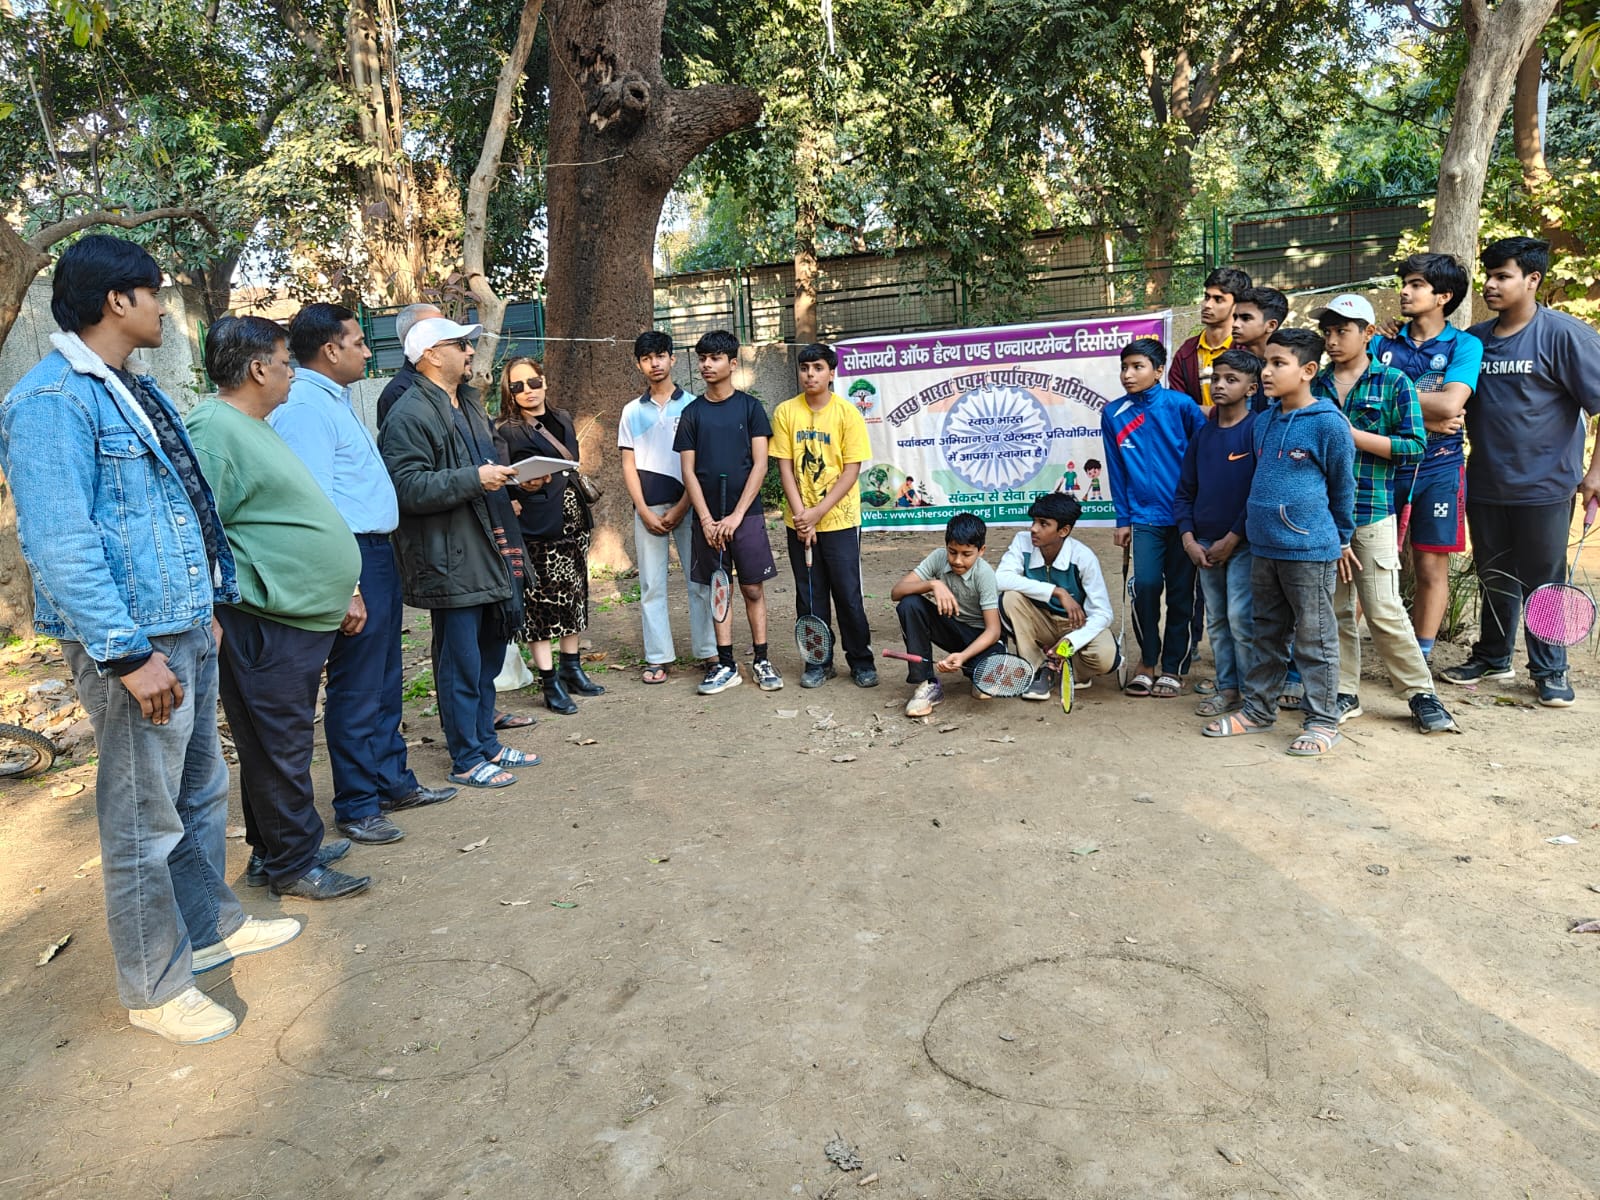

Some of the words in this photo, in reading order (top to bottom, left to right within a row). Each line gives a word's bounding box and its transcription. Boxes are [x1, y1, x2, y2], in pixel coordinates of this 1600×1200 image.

[843, 345, 896, 371] सोसायटी
[900, 344, 930, 365] ऑफ
[933, 340, 961, 364] हैल्थ
[964, 342, 991, 361] एण्ड
[994, 332, 1072, 359] एन्वायरमेन्ट
[1074, 326, 1134, 352] रिसोर्सेज
[1382, 351, 1393, 367] 9
[886, 396, 920, 427] स्वच्छ
[919, 380, 954, 405] भारत
[953, 371, 992, 393] एवम्
[990, 365, 1051, 391] पर्यावरण
[1051, 376, 1109, 413] अभियान
[968, 417, 995, 427] स्वच्छ
[997, 415, 1024, 425] भारत
[897, 436, 935, 448] पर्यावरण
[939, 434, 981, 446] अभियान
[985, 431, 1001, 443] एवं
[1003, 430, 1043, 444] खेलकूद
[1046, 426, 1102, 440] प्रतियोगिता
[947, 451, 958, 462] में
[959, 452, 994, 462] आपका
[997, 448, 1031, 459] स्वागत
[948, 490, 985, 504] संकल्प
[988, 488, 999, 502] से
[1002, 488, 1025, 501] सेवा
[889, 507, 991, 519] www.shersocietorg
